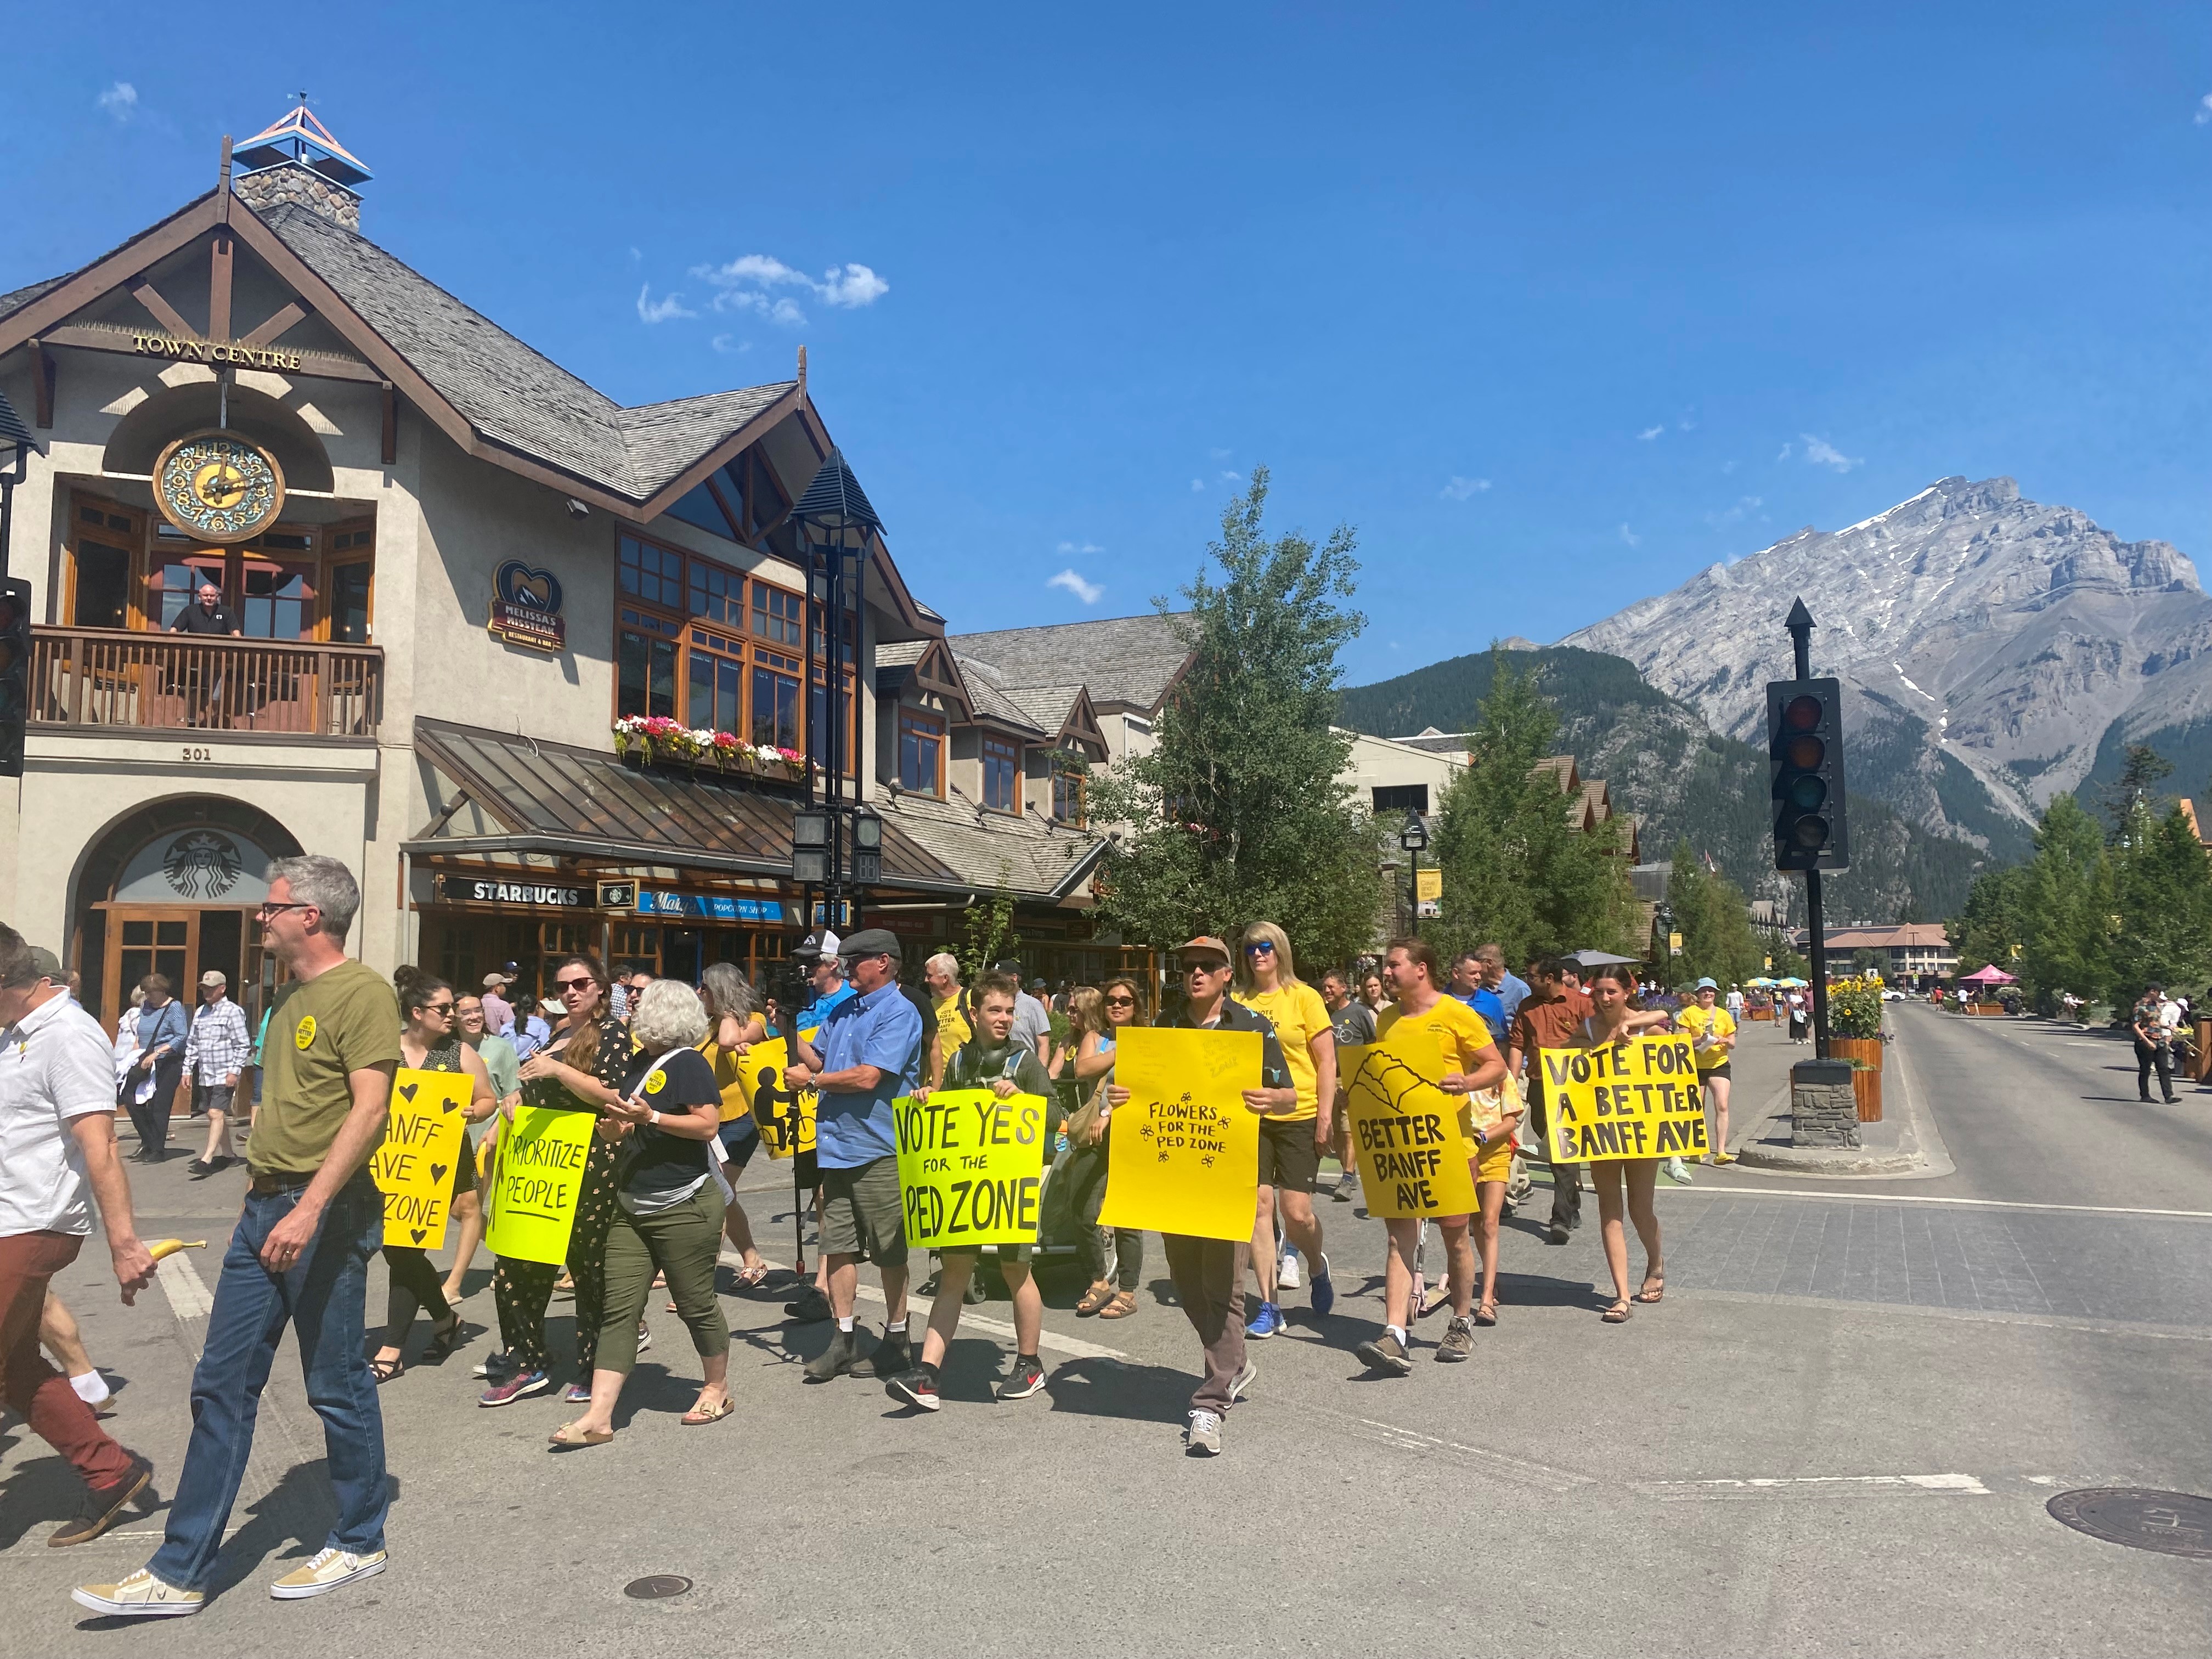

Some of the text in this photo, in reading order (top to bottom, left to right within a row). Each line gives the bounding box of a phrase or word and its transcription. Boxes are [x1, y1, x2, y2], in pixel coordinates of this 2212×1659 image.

[133, 335, 300, 369] TOWN CENTRE
[194, 444, 207, 459] 11
[211, 442, 231, 456] 12
[238, 449, 245, 462] 1
[175, 457, 195, 471] 10
[250, 464, 262, 476] 2
[172, 475, 186, 489] 9
[255, 479, 268, 497] 3
[176, 492, 190, 505] 8
[249, 496, 261, 514] 4
[191, 506, 205, 522] 7
[211, 516, 225, 530] 6
[234, 512, 246, 525] 5
[505, 605, 556, 625] MELISSA'S
[507, 616, 555, 635] MISSTEAK
[508, 631, 536, 643] RESTAURANT
[183, 748, 211, 761] 301
[474, 882, 578, 905] STARBUCKS
[650, 891, 768, 917] Mary's POPCORN SHOP
[1544, 1042, 1695, 1085] VOTE FOR
[1149, 1102, 1218, 1120] FLOWERS
[1555, 1082, 1702, 1123] A BETTER
[386, 1113, 444, 1148] ANFF
[895, 1101, 1040, 1155] VOTE YES
[1158, 1121, 1216, 1137] FOR THE
[1358, 1114, 1446, 1151] BETTER
[1156, 1136, 1227, 1153] PED ZONE
[1556, 1118, 1706, 1159] BANFF AVE
[507, 1134, 584, 1169] PRIORITIZE
[923, 1154, 988, 1173] FOR THE
[1373, 1149, 1441, 1182] BANFF
[506, 1176, 567, 1209] PEOPLE
[1397, 1180, 1438, 1210] AVE
[383, 1193, 441, 1227] ZONE
[906, 1177, 1040, 1240] PED ZONE
